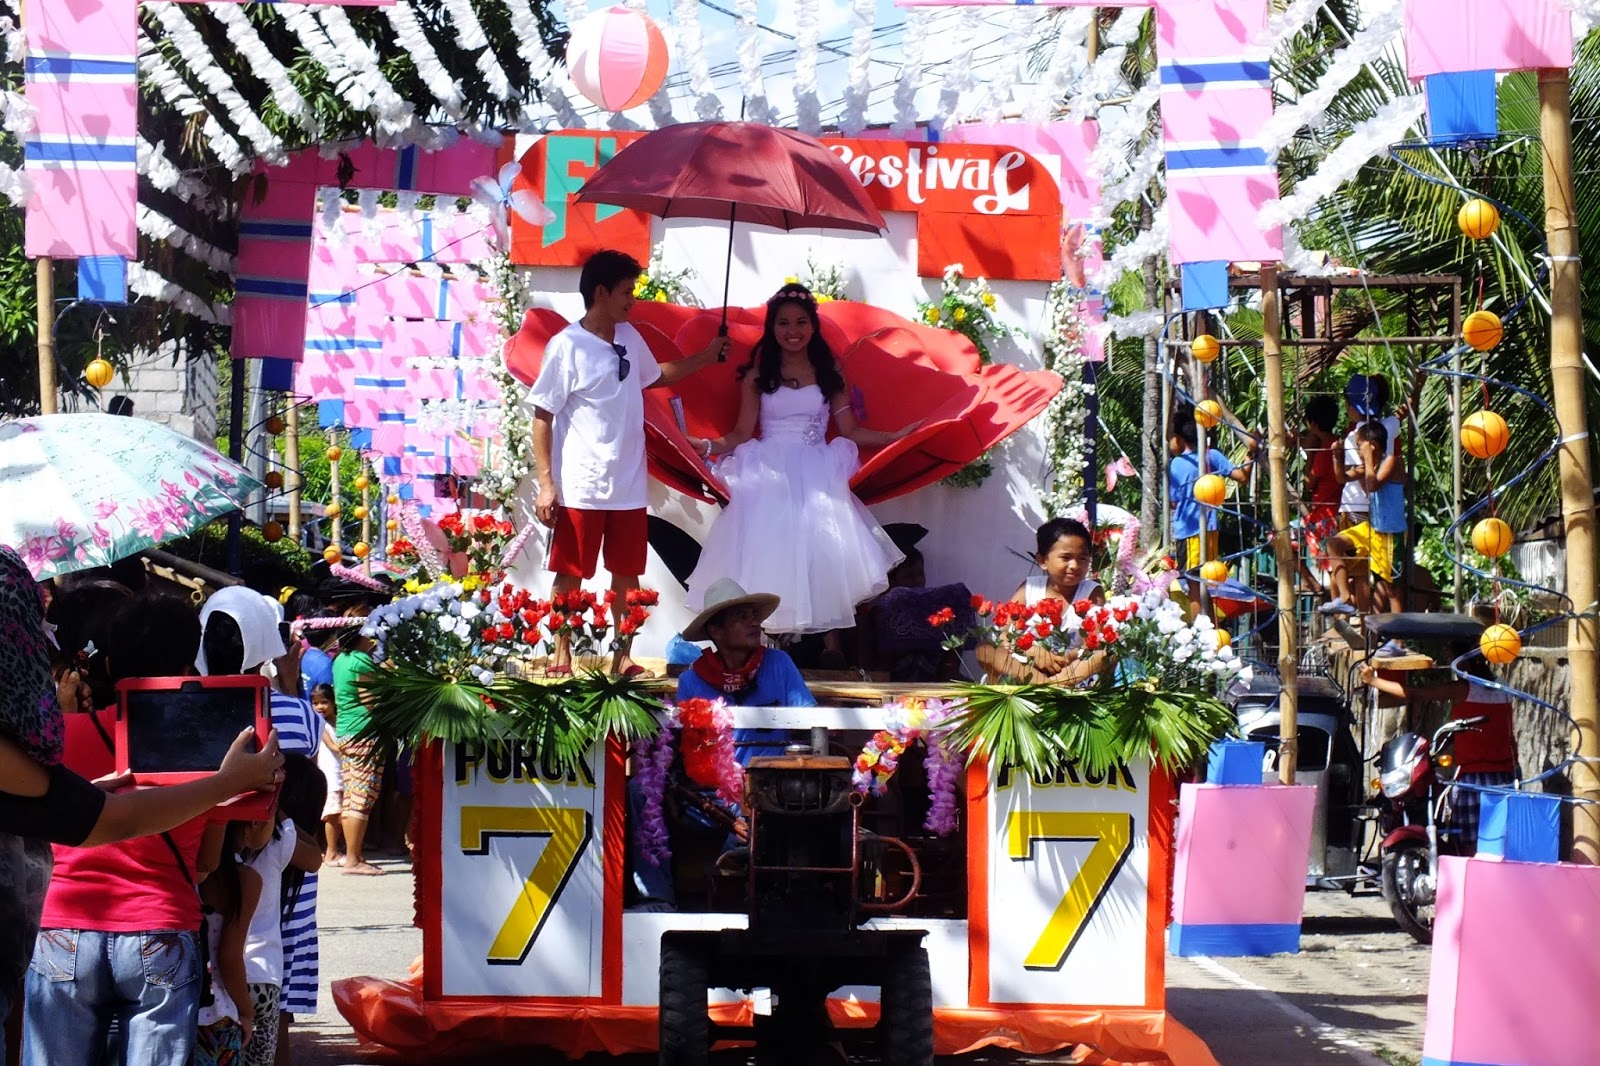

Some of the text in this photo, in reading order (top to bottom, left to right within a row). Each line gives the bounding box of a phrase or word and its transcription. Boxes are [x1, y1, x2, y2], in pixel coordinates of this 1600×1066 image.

[455, 737, 596, 788] PUROK
[461, 806, 592, 965] 7
[1009, 812, 1134, 971] 7
